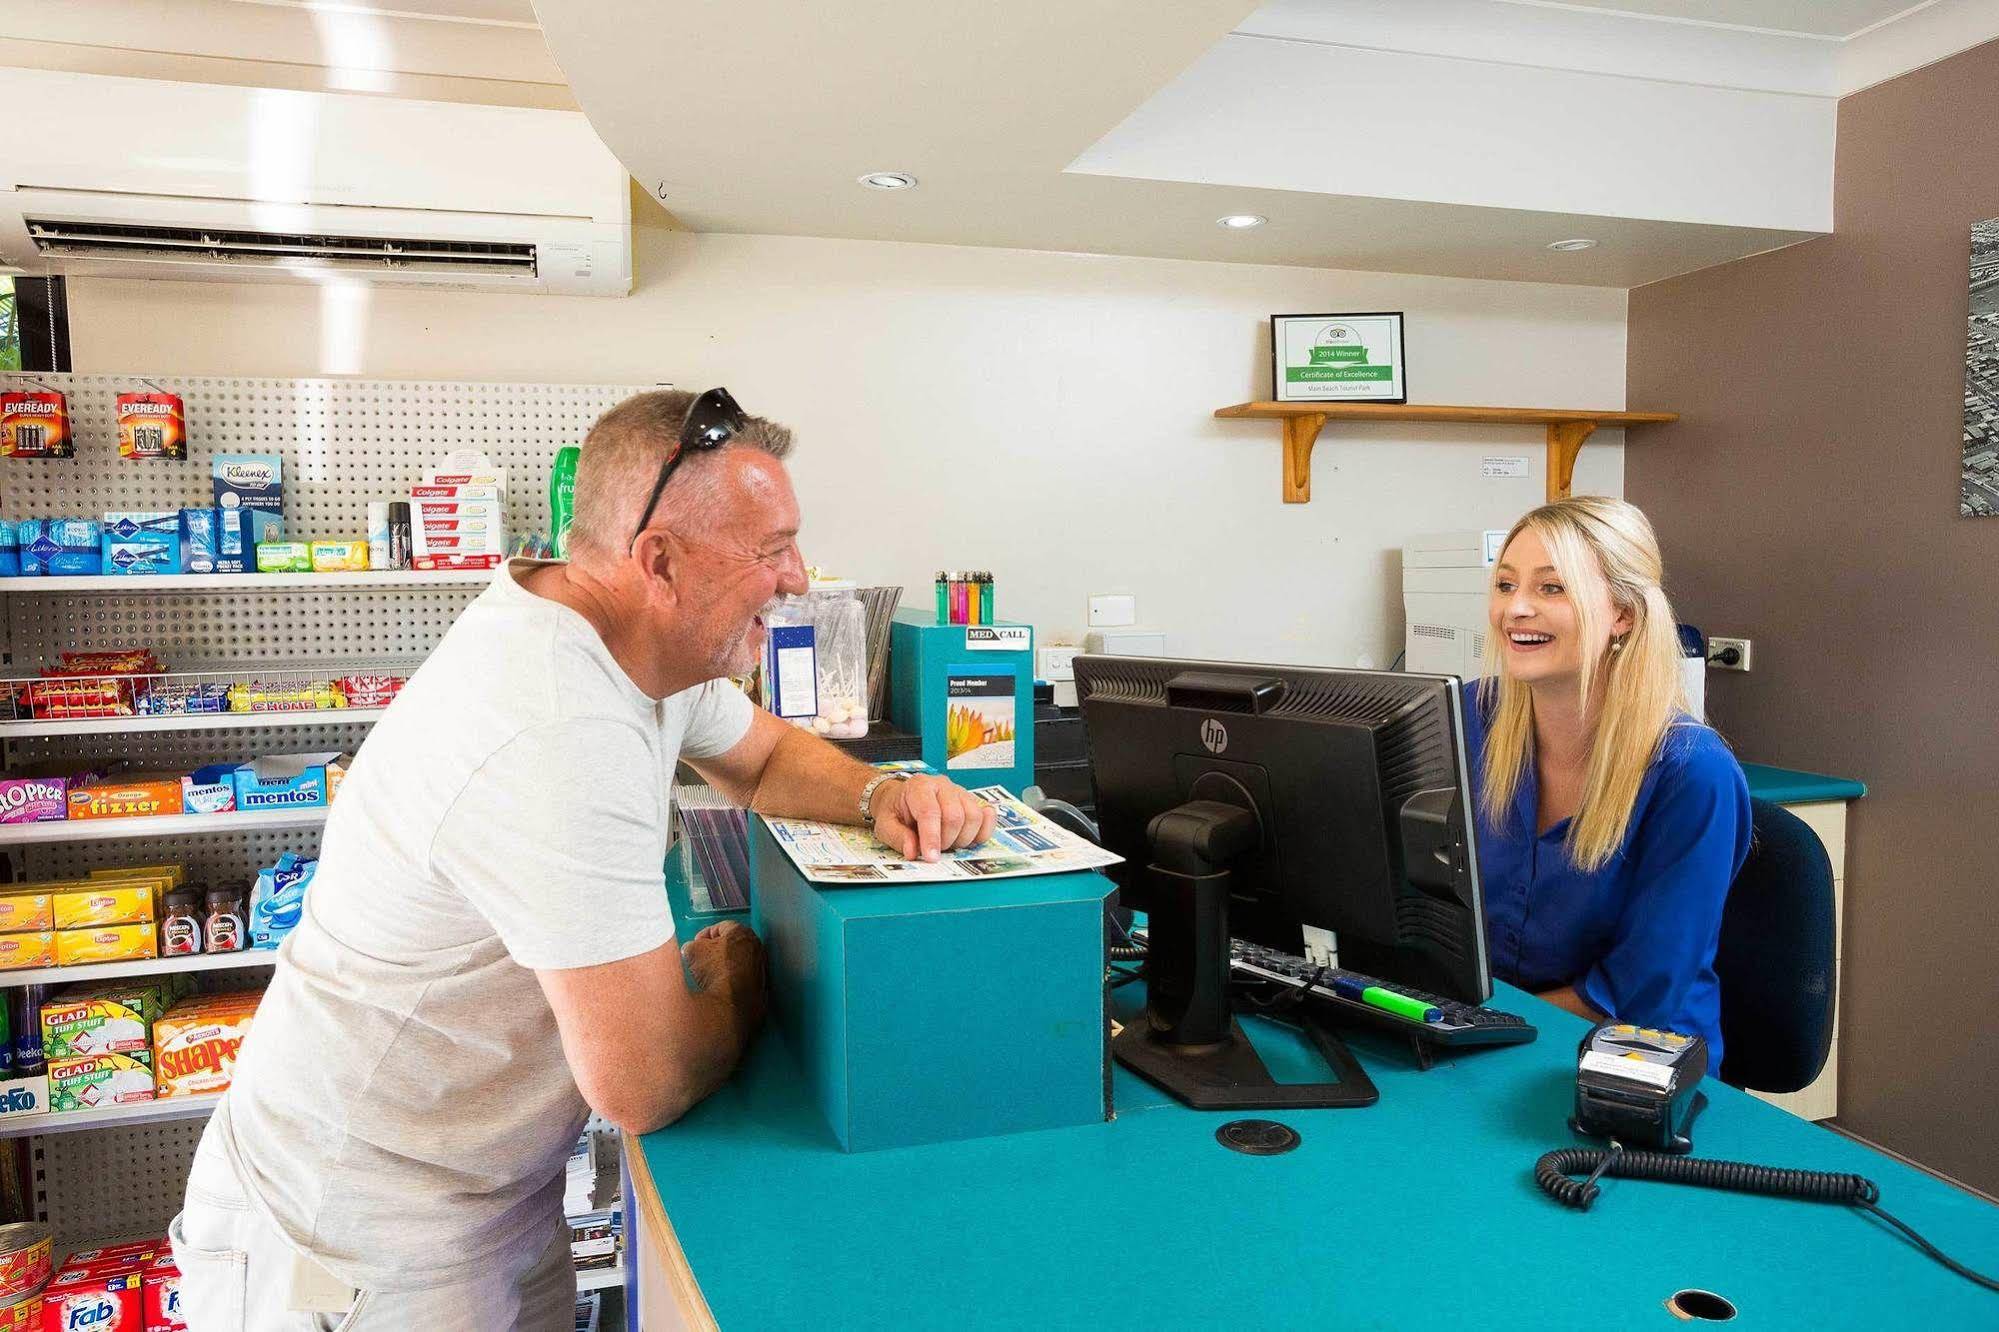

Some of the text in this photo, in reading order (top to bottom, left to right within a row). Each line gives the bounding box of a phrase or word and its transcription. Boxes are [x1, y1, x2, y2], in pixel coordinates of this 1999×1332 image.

[1300, 371, 1334, 379] Certificate
[5, 402, 58, 414] EVEREADY
[121, 403, 174, 414] EVEREADY
[227, 466, 271, 480] Kleenex
[436, 476, 469, 485] Colgate
[416, 489, 449, 498] Colgate
[422, 505, 450, 514] olgate
[424, 522, 451, 531] olgate
[968, 630, 1026, 639] MED CALL
[252, 701, 316, 711] CHOMP
[1205, 719, 1224, 752] hp
[187, 784, 230, 797] mentos
[245, 789, 319, 805] mentos
[90, 799, 160, 815] fizzer
[92, 898, 115, 908] Lipton
[96, 934, 119, 943] Lipton
[0, 942, 19, 951] pton
[46, 1009, 87, 1025] GLAD
[55, 1018, 102, 1034] TUFF STUFF
[53, 1062, 95, 1079] GLAD
[63, 1070, 110, 1088] TUFF STUFF
[69, 1302, 114, 1329] Fab
